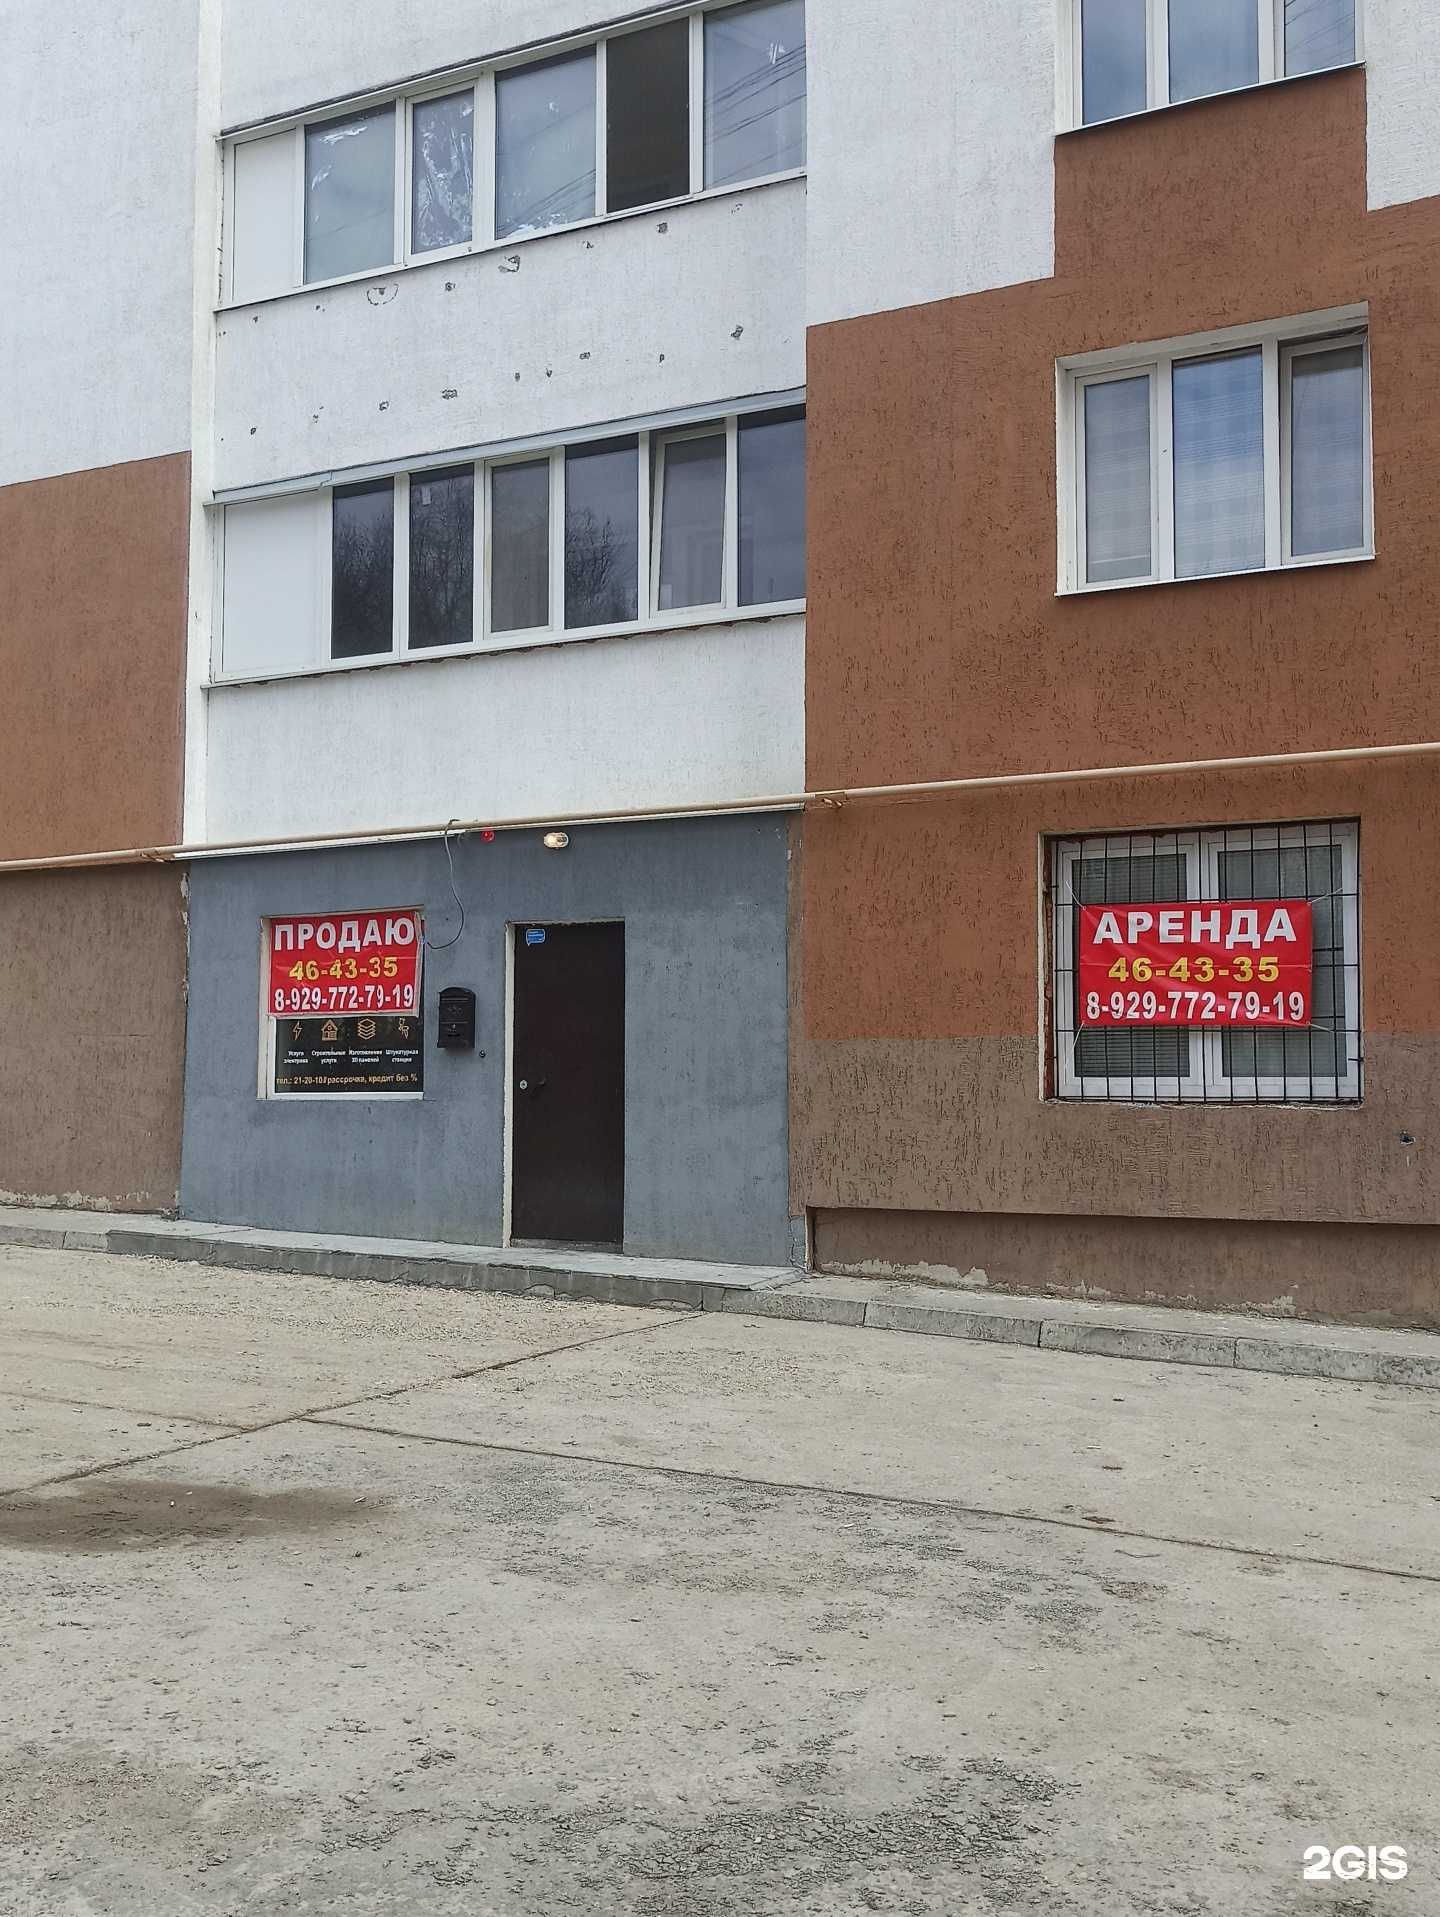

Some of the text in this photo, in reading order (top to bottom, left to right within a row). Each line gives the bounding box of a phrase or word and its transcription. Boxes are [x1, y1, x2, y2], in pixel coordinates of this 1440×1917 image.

[274, 917, 415, 954] ПРОДАЮ
[1092, 908, 1297, 949] АРЕНДА
[288, 956, 399, 981] 46-43-35
[1108, 956, 1280, 983] 46-43-35
[274, 984, 415, 1011] 8-929-772-79-19
[1086, 990, 1305, 1020] 8-929-772-79-19
[368, 1075, 395, 1085] кредит
[396, 1073, 409, 1082] без
